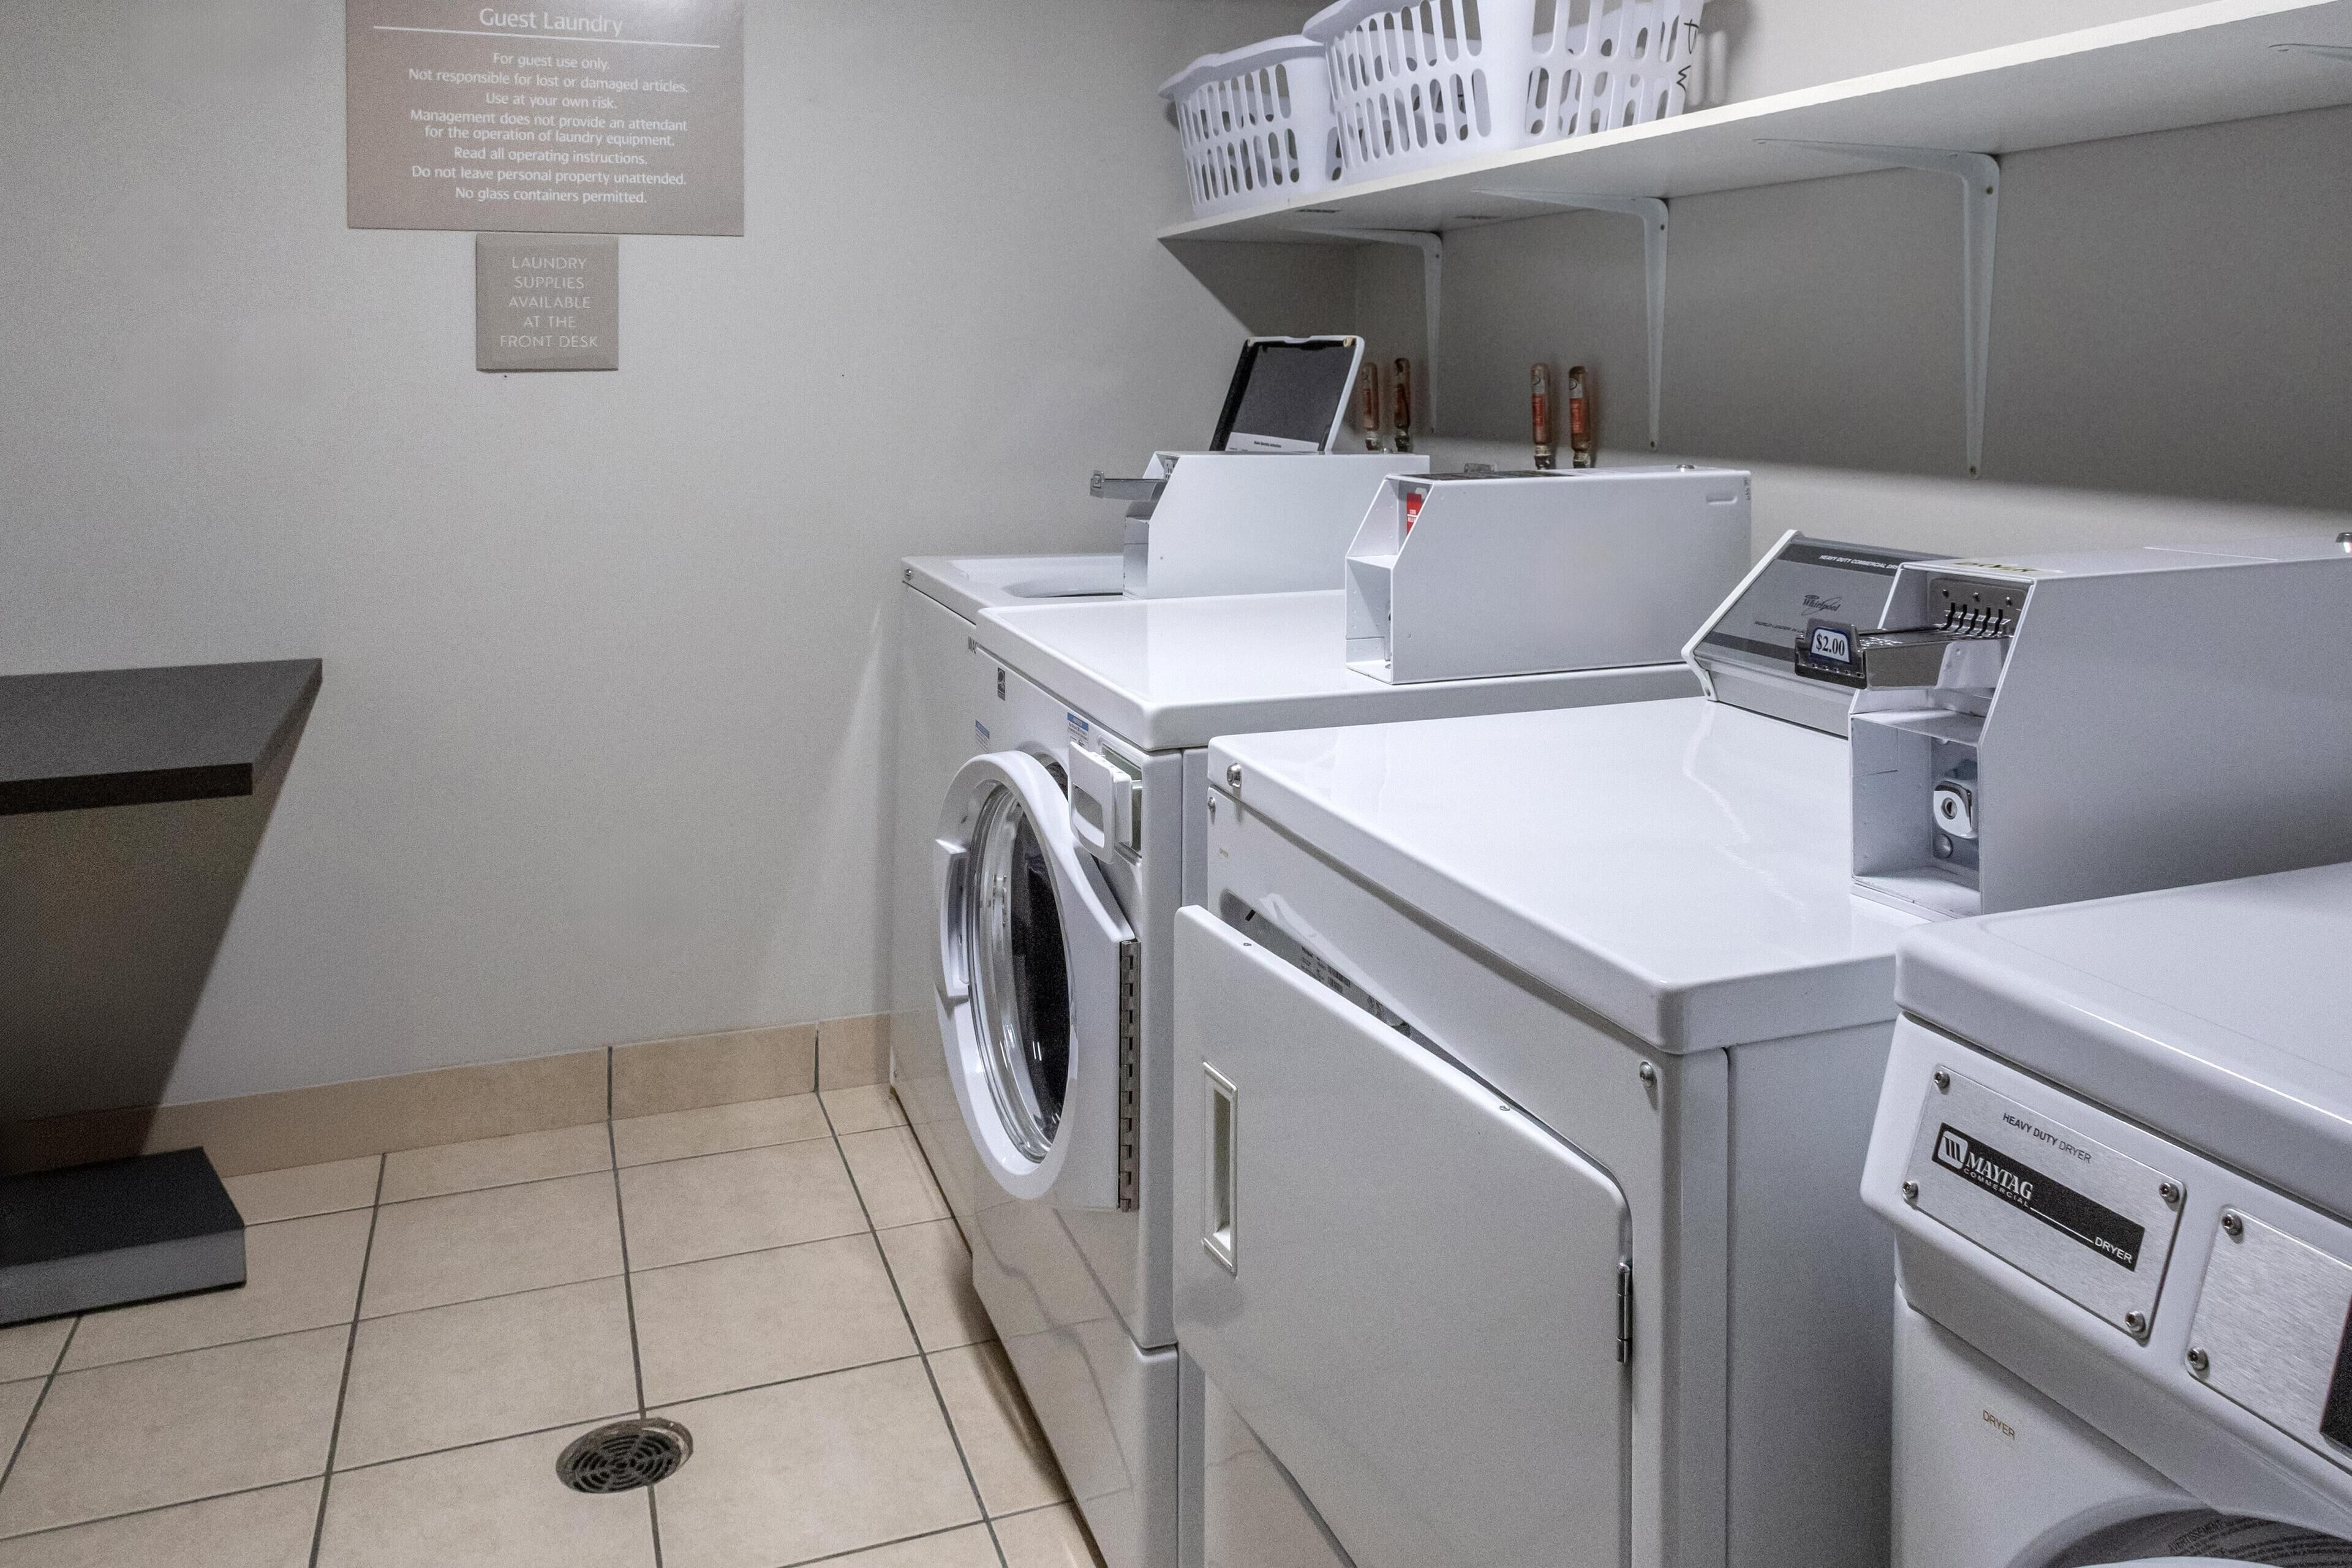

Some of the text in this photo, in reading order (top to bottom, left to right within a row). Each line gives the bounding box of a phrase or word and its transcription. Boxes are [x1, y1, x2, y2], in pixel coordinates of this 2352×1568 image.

[479, 8, 624, 37] Guest Laundry
[493, 53, 611, 72] For guest use only.
[409, 68, 688, 92] Not responsible for lost or damaged articles.
[486, 93, 618, 108] Use at your own risk.
[410, 110, 688, 131] Management does not provide an attendant
[424, 124, 675, 148] for the operation of laundry equipment.
[454, 146, 648, 165] Read all operating instructions.
[412, 165, 687, 186] Do not leave personal property unattended.
[455, 187, 647, 204] No glass containers permitted.
[511, 257, 587, 270] LAUNDRY
[514, 276, 584, 289] SUPPLIES
[508, 296, 591, 309] AVAILABLE
[522, 315, 577, 328] AT THE
[500, 335, 598, 349] FRONT DESK
[1802, 597, 1842, 612] Whirlpool
[1815, 633, 1845, 657] $2.00
[2003, 1112, 2092, 1164] HEAVY DUTY DRYER
[1966, 1152, 2034, 1201] MAYTAG
[1962, 1167, 2030, 1208] COMMERCIAL
[2095, 1236, 2133, 1264] DRYER
[1983, 1410, 2015, 1441] DRYER
